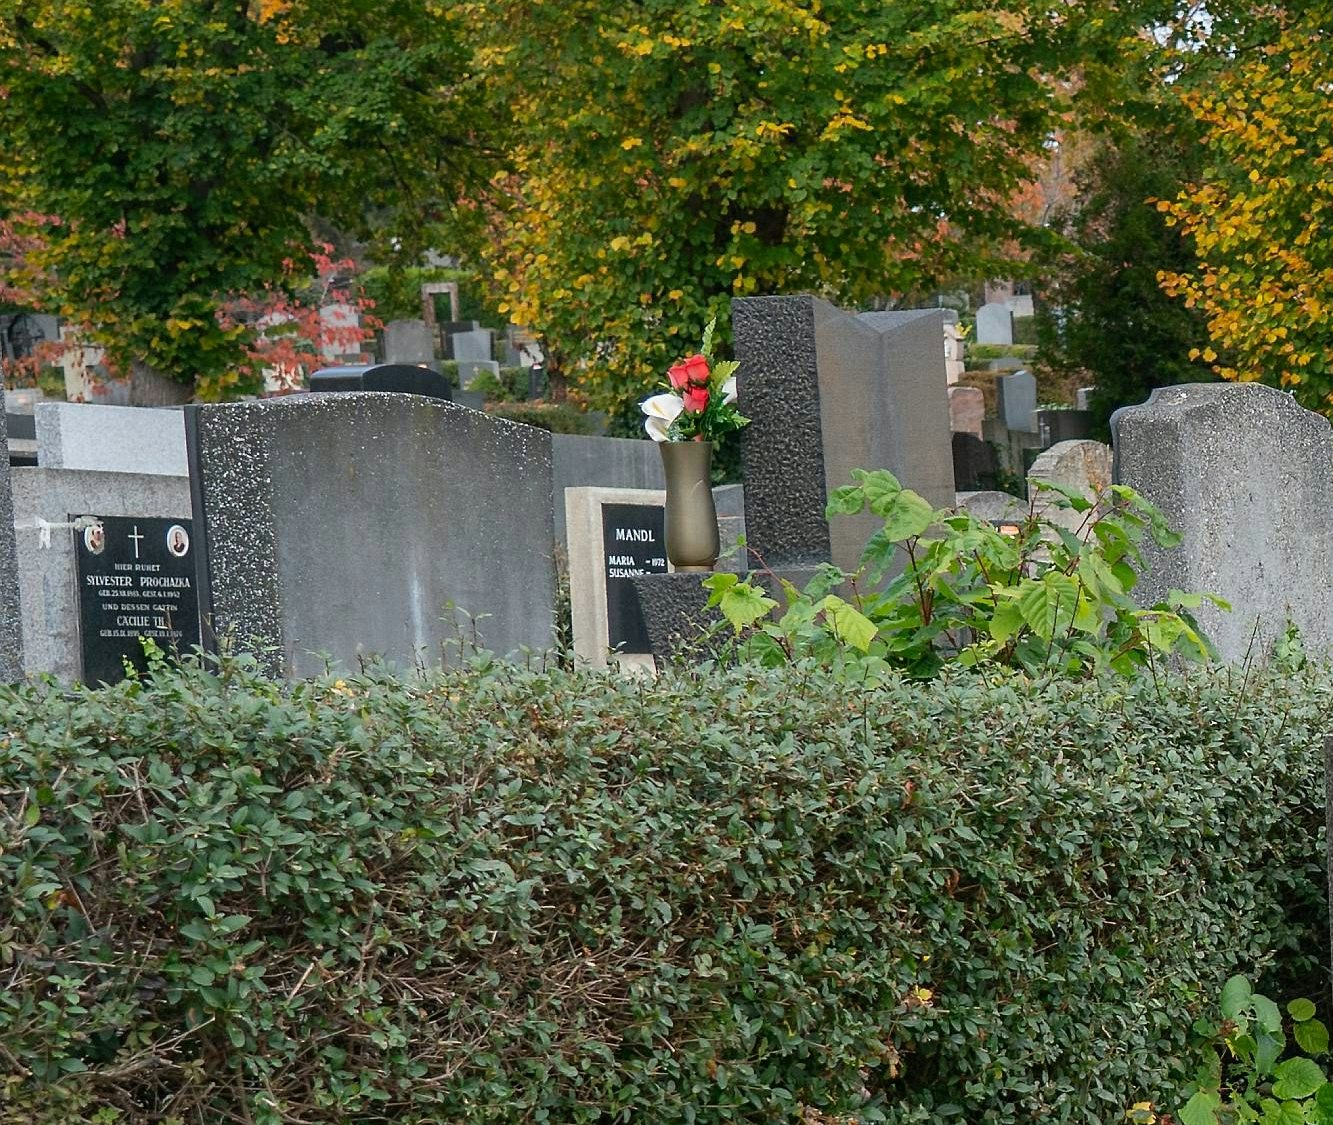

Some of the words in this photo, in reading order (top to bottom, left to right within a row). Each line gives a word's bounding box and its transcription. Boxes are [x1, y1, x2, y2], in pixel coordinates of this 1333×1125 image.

[616, 528, 655, 542] MANDL
[609, 556, 635, 566] MARIA
[114, 563, 132, 571] HIER
[609, 568, 644, 578] SUSANNE
[86, 575, 132, 586] SYLVESTER
[140, 576, 190, 588] PROCHAZKA
[116, 616, 150, 626] CÄCILIE
